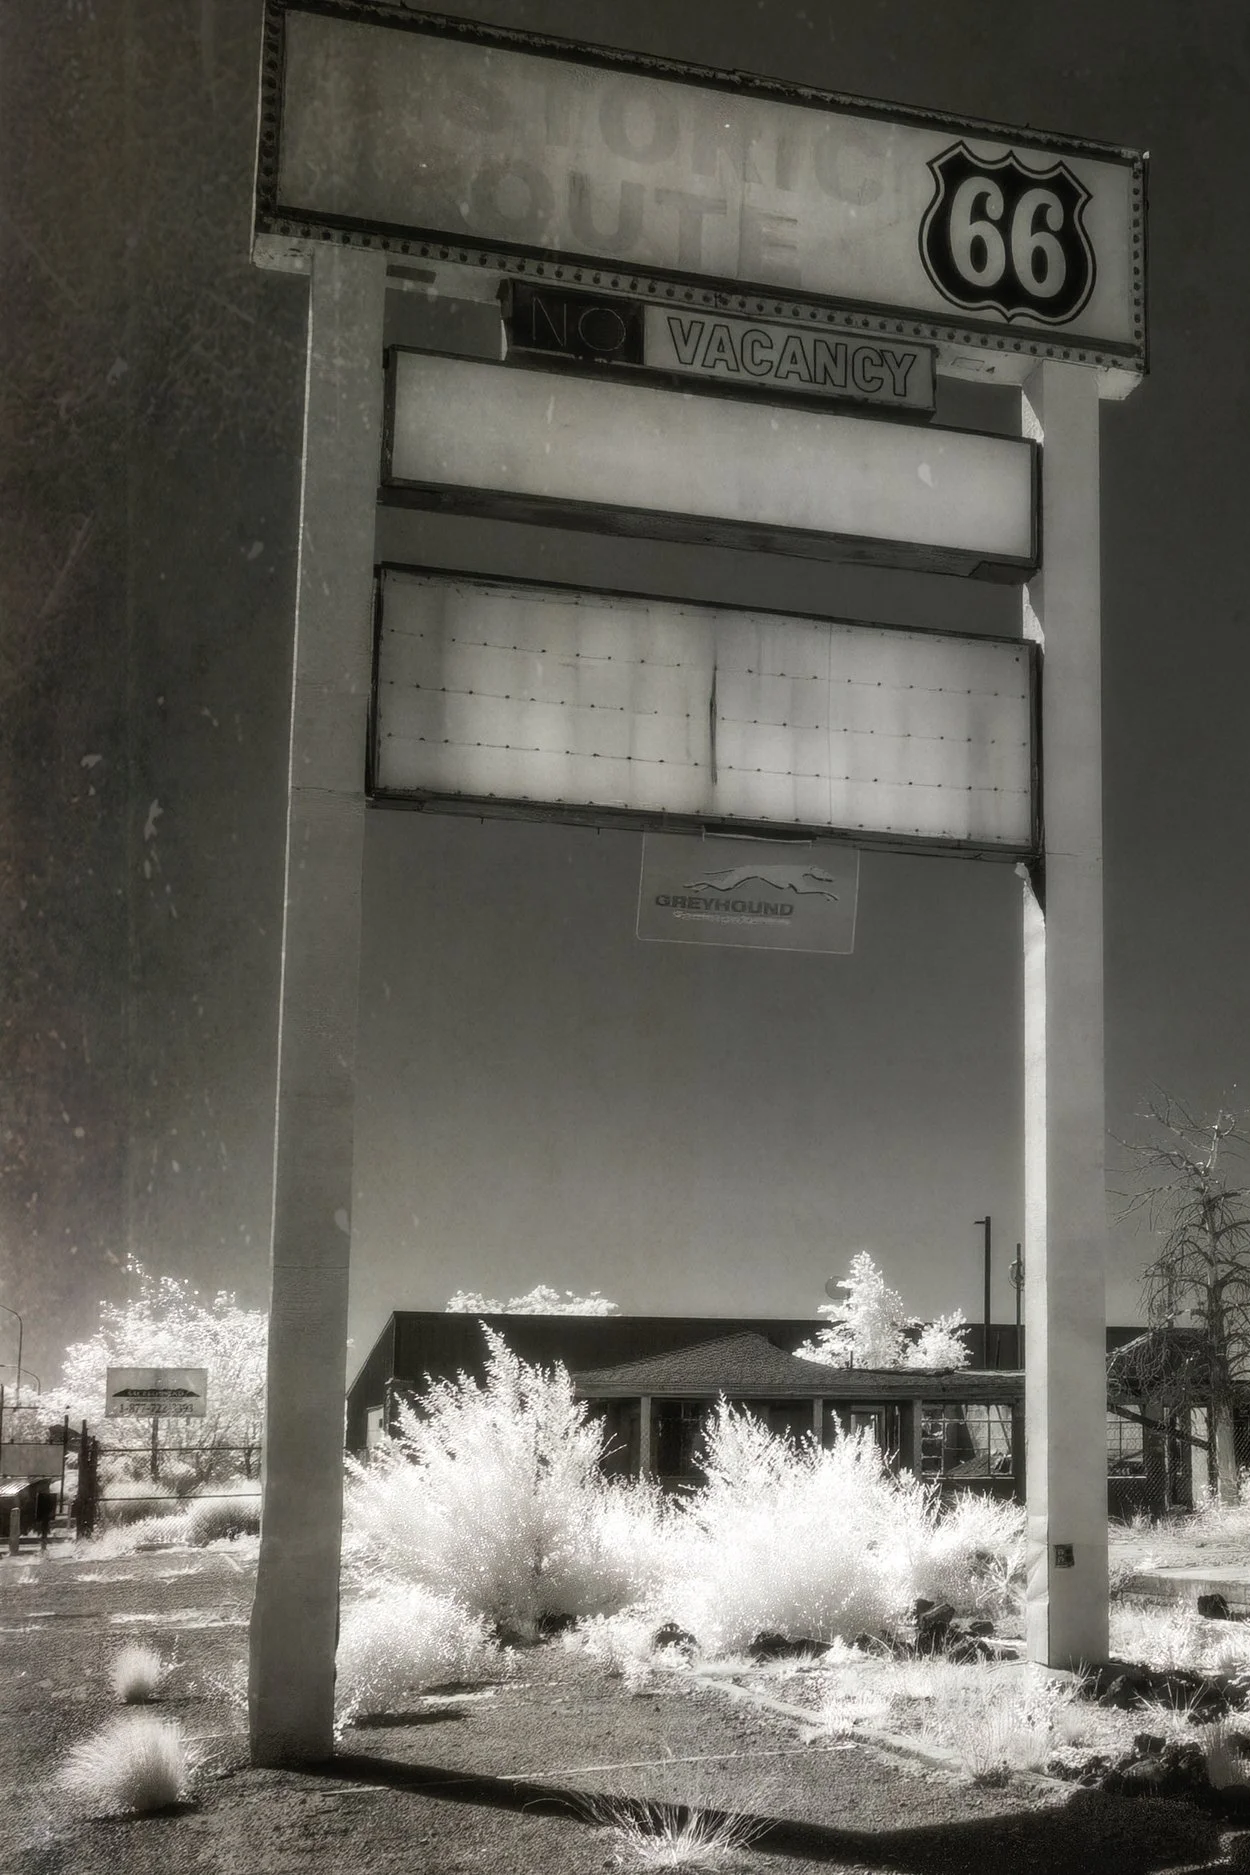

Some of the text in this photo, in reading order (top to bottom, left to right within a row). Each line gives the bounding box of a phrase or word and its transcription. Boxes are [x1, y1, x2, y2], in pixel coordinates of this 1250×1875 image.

[950, 176, 1066, 298] 66
[532, 296, 917, 396] NO VACANCY
[655, 894, 794, 916] GREYHOUND
